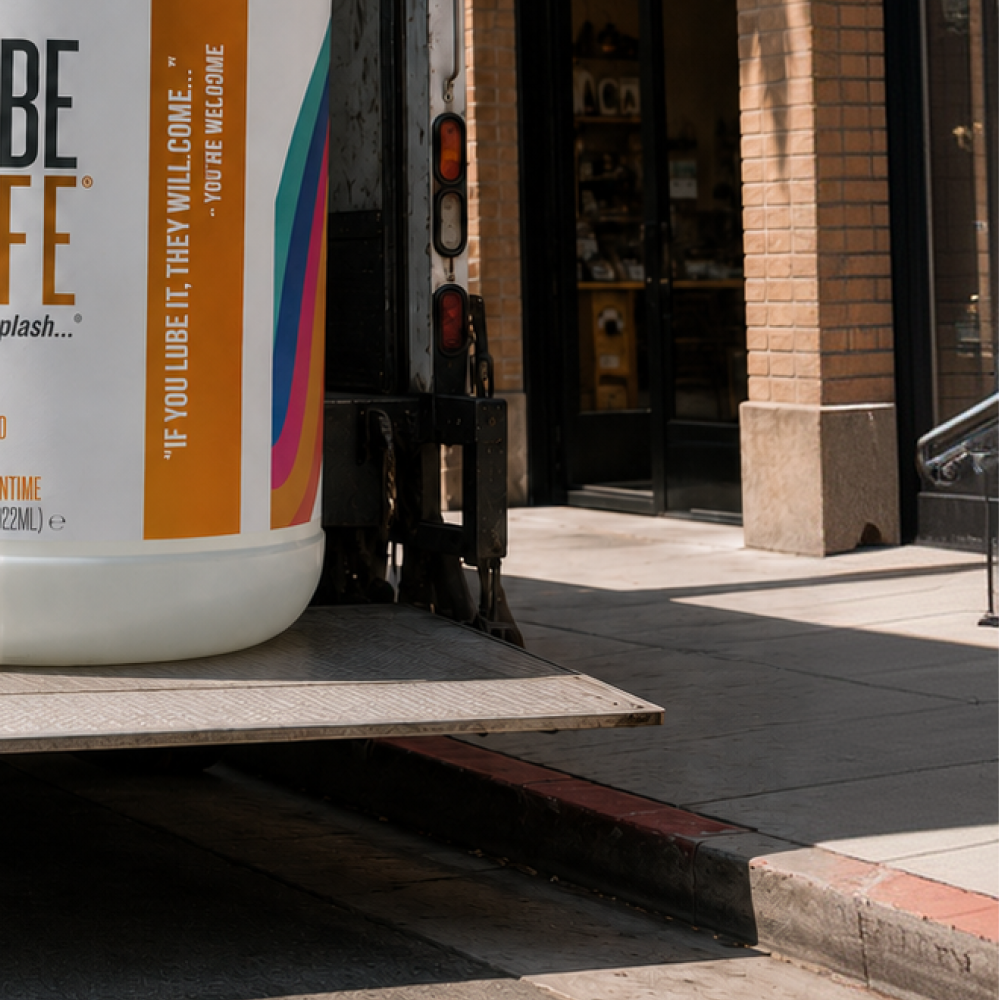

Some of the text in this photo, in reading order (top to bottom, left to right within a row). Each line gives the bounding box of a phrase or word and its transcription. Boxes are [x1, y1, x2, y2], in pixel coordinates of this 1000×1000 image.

[165, 218, 189, 278] THEY
[165, 283, 192, 308] IT,
[165, 314, 189, 371] LUBE
[164, 377, 189, 422] YOU
